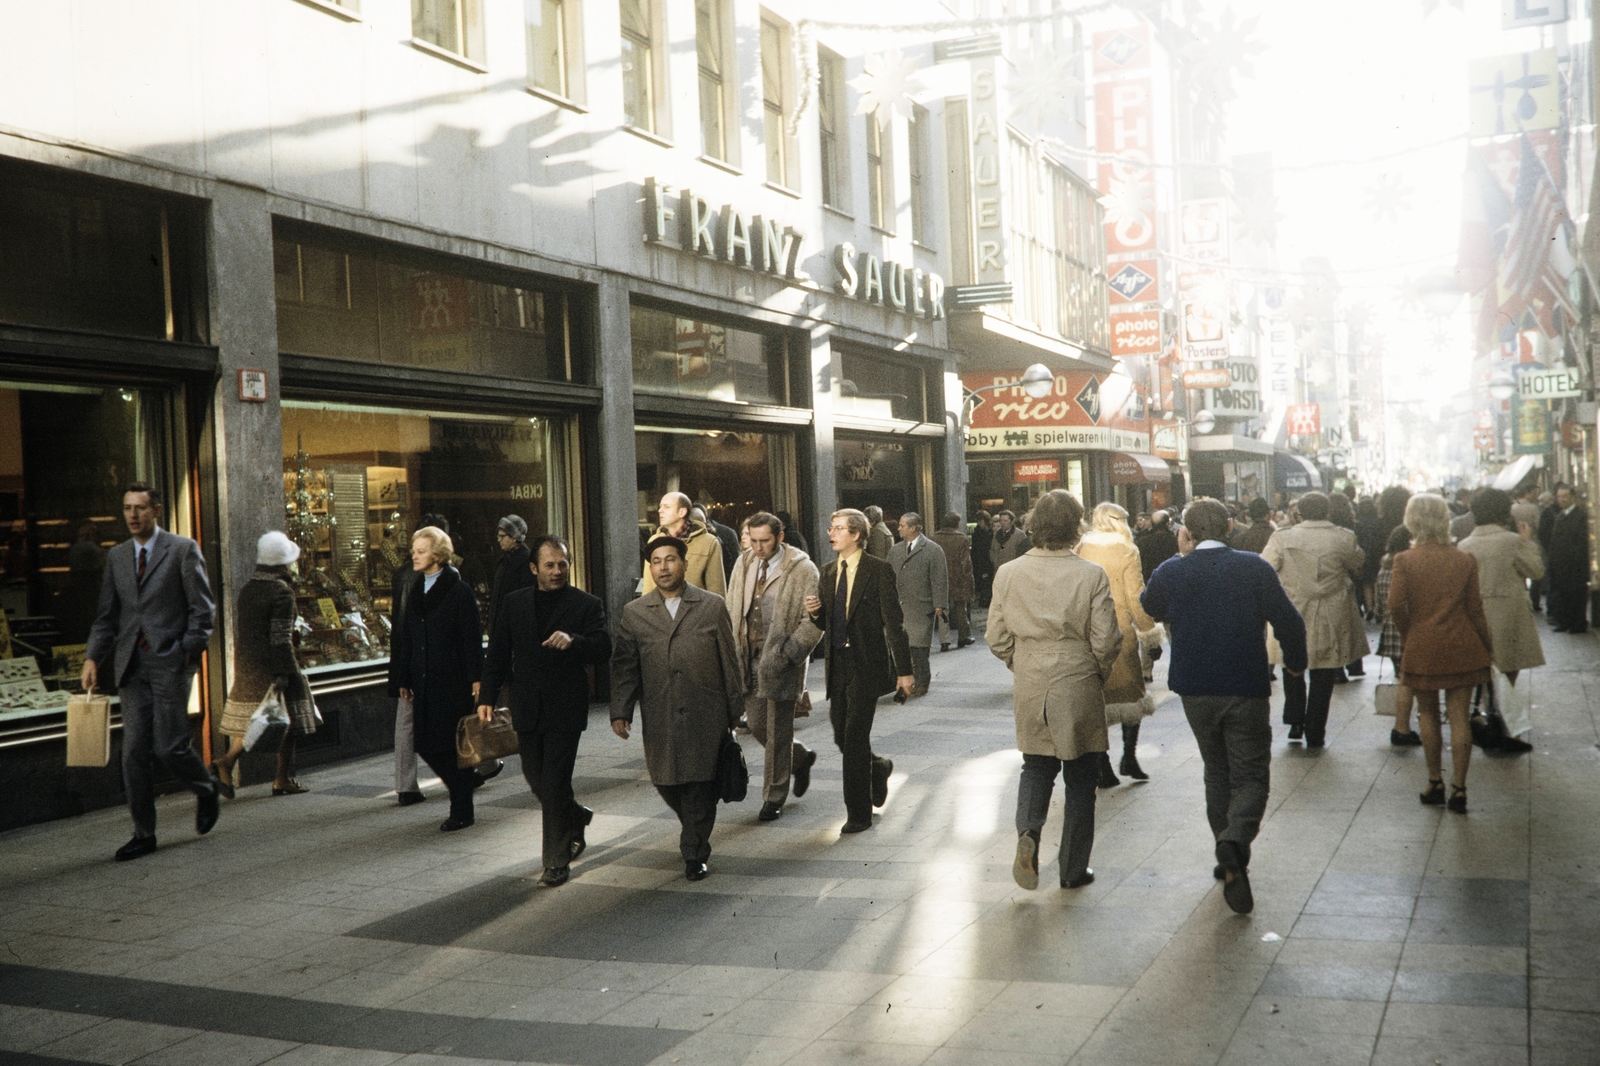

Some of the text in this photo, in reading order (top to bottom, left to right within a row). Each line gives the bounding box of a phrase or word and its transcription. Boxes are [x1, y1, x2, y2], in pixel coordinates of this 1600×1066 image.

[972, 69, 1003, 272] SAUER
[1111, 84, 1153, 247] PHOO
[643, 176, 810, 281] FRANZ
[1183, 245, 1220, 260] Sex
[834, 241, 945, 321] SAUER
[1111, 272, 1147, 294] Agfa
[1115, 318, 1159, 335] photo
[1116, 334, 1159, 349] rico
[1184, 345, 1228, 358] Posters
[993, 375, 1067, 397] PHO
[993, 396, 1070, 421] rico
[1212, 388, 1259, 410] PORST
[965, 433, 998, 447] bby
[1034, 430, 1098, 445] spielwaren
